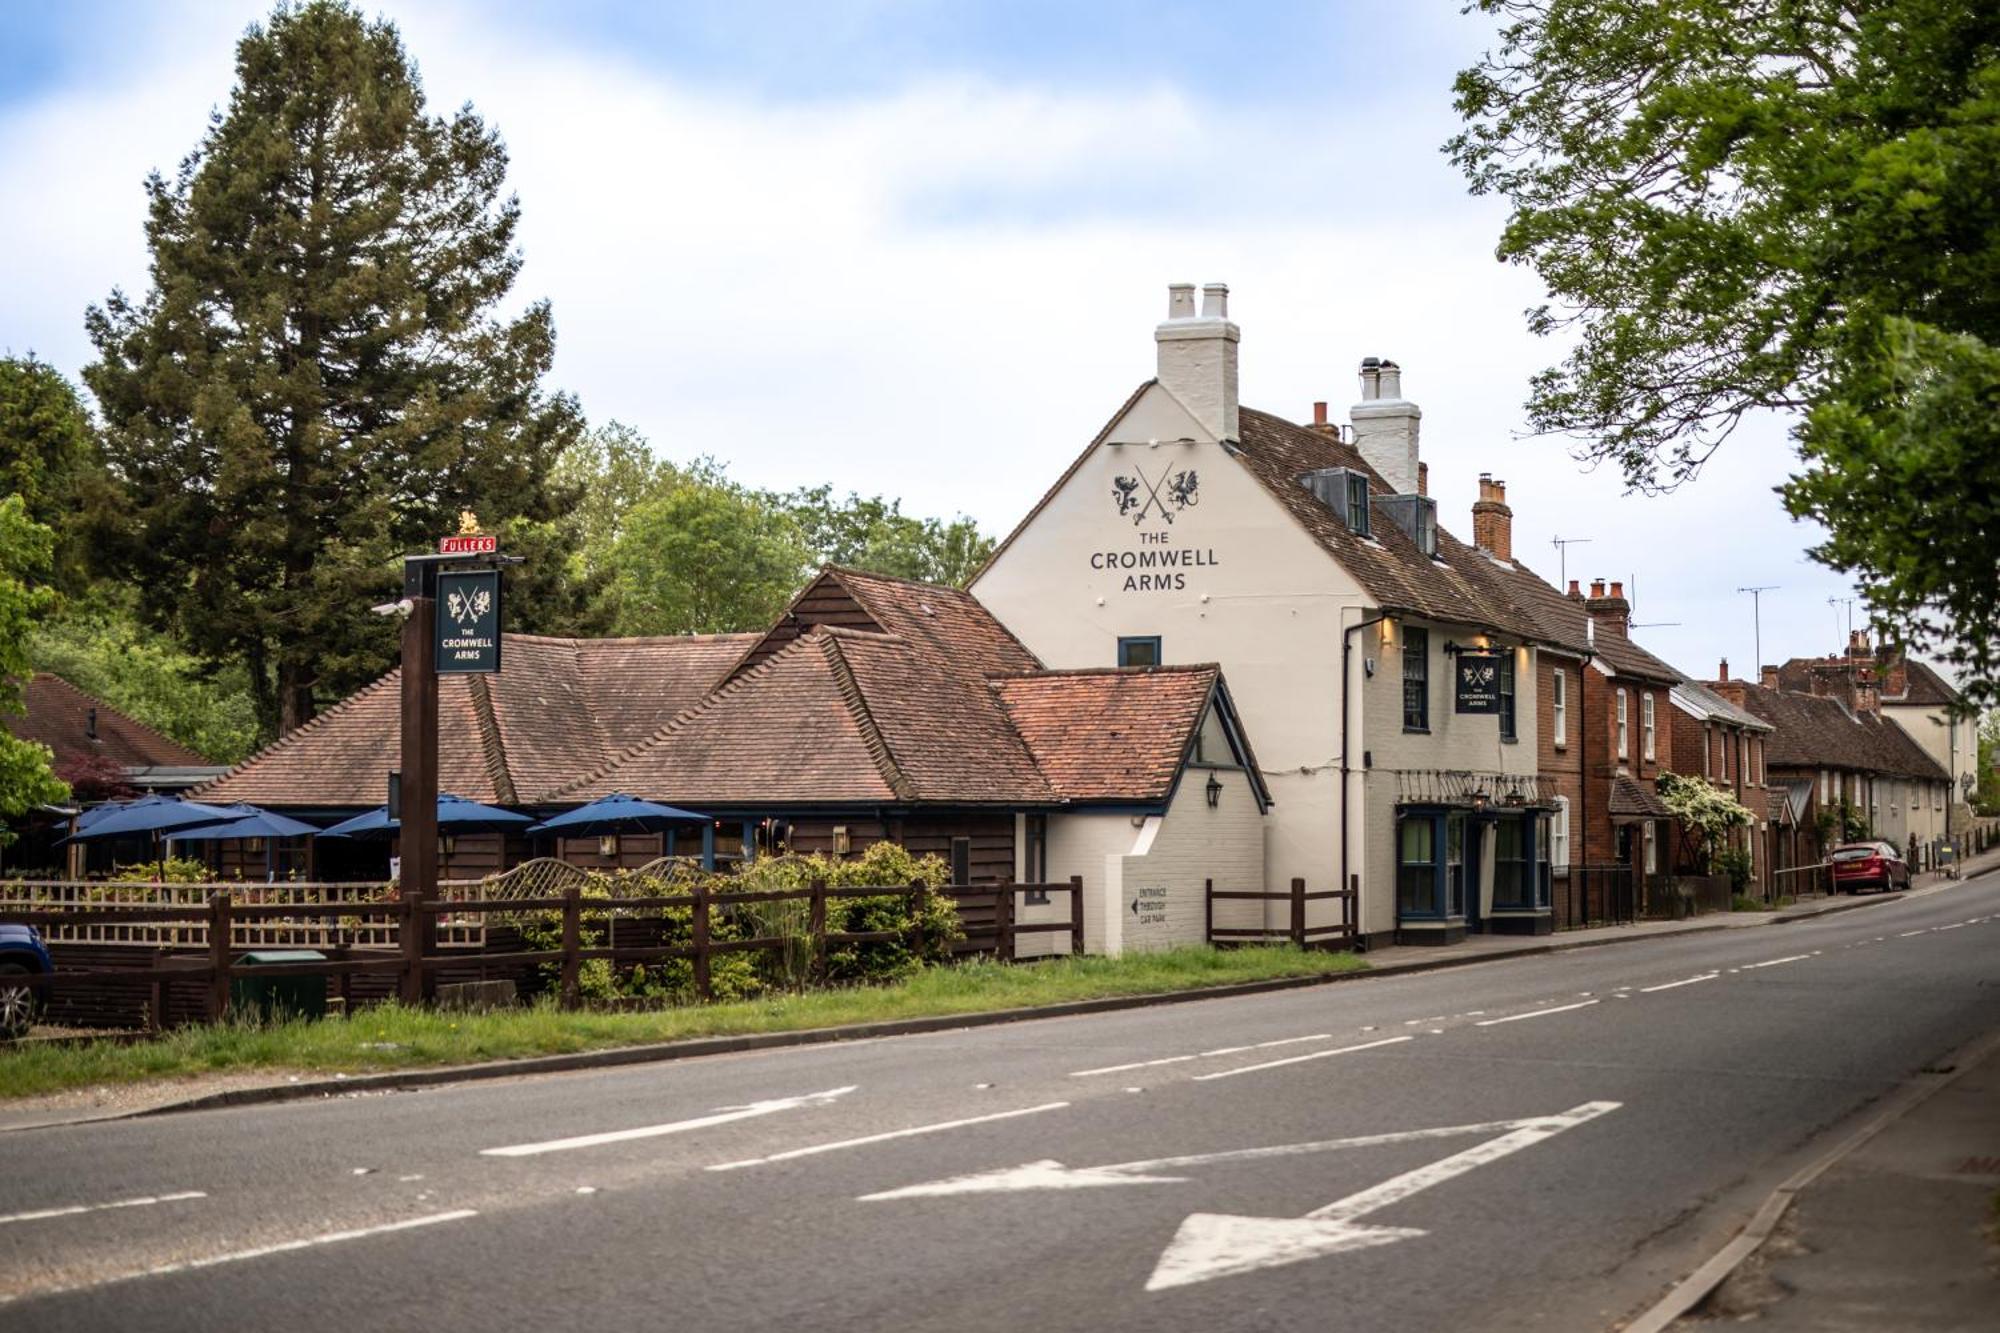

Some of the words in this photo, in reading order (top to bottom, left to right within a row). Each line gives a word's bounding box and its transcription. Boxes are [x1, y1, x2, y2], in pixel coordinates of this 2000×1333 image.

[1139, 532, 1169, 544] THE
[443, 538, 492, 552] FULLER'S
[1090, 549, 1219, 570] CROMWELL
[1123, 573, 1186, 591] ARMS
[461, 628, 474, 636] THE
[442, 638, 493, 648] CROMWELL
[454, 650, 480, 660] ARMS
